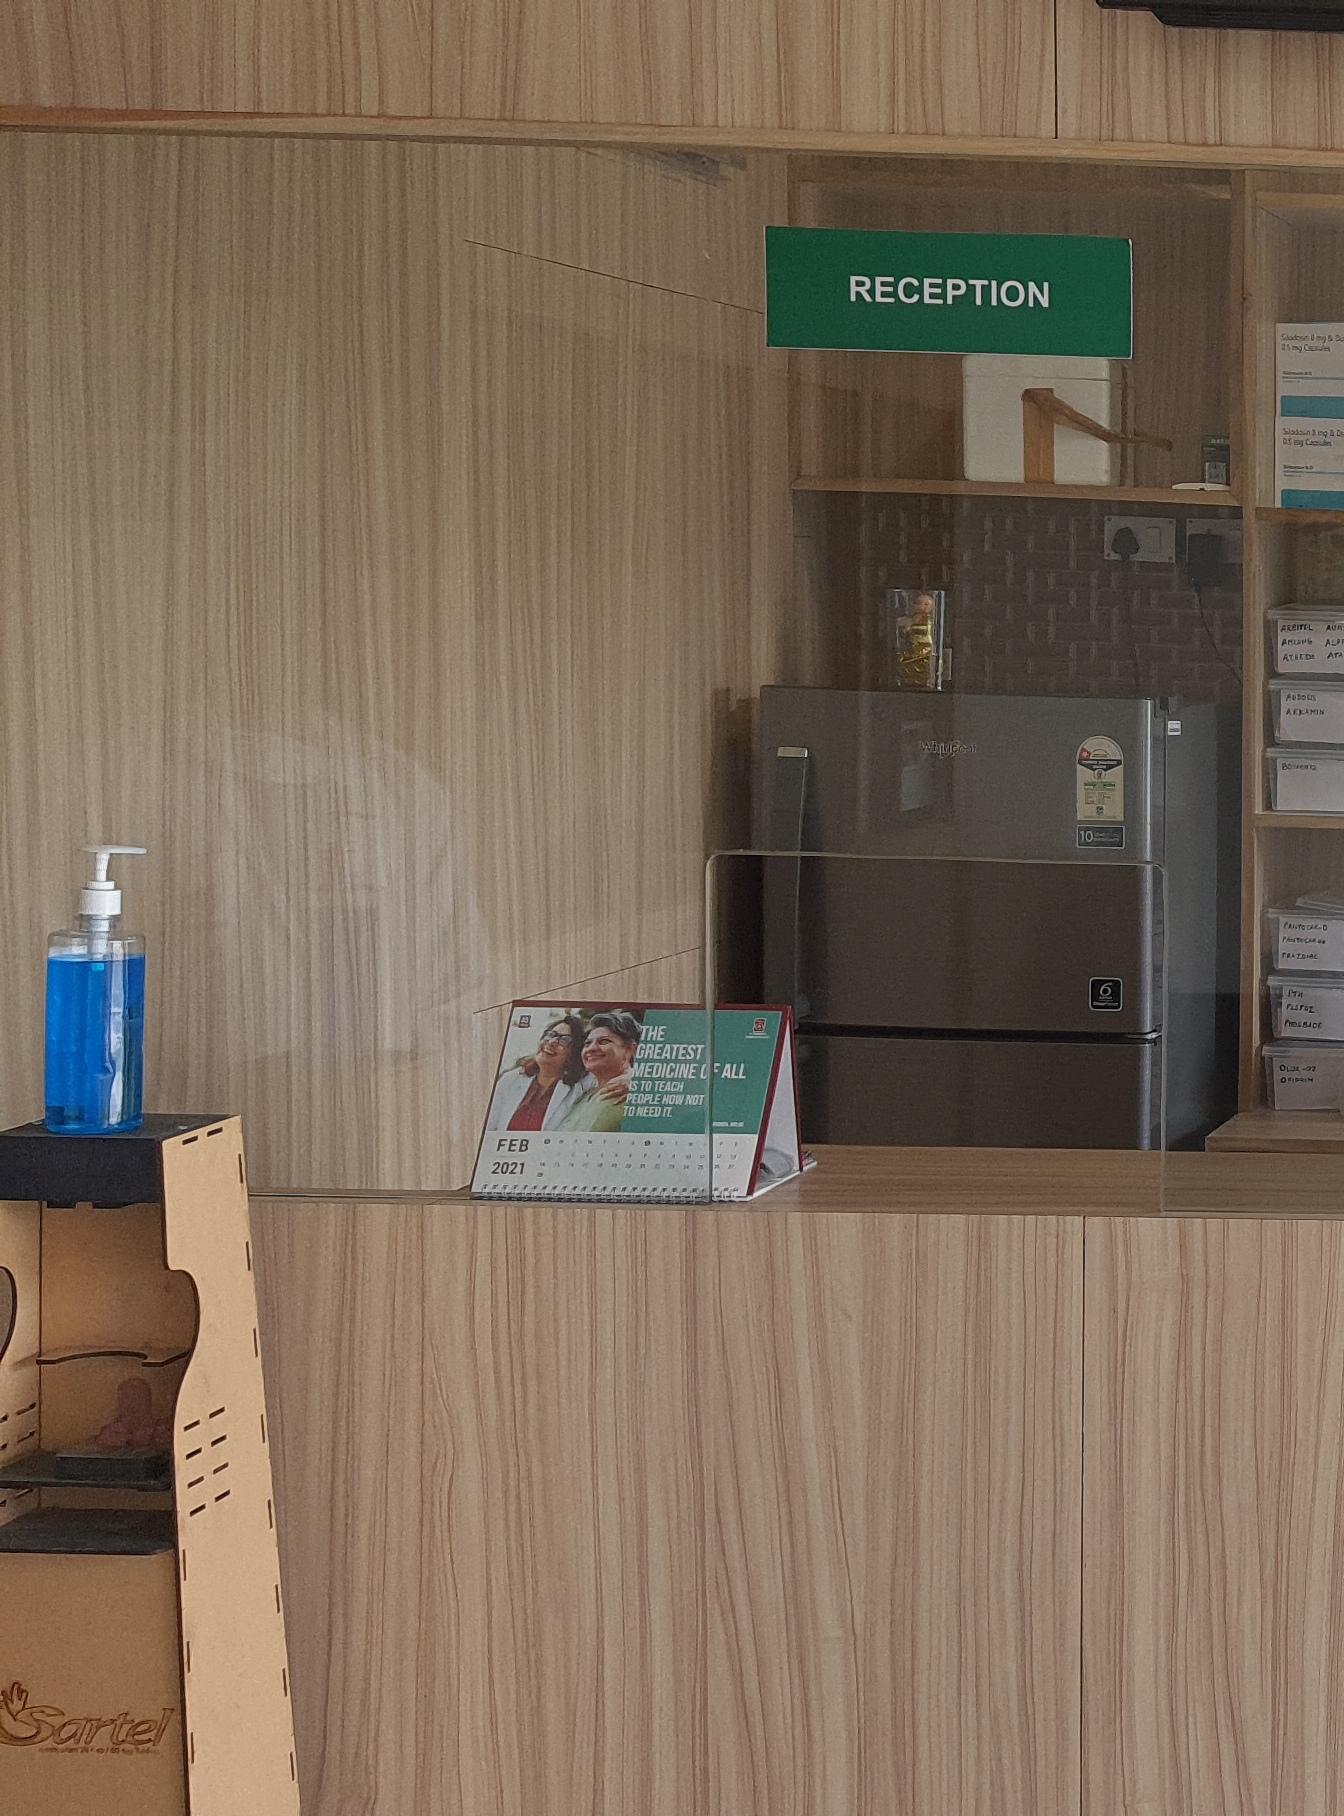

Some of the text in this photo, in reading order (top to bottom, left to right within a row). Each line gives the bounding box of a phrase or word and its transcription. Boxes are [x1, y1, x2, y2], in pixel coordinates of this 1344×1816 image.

[848, 274, 1051, 310] RECEPTION
[1079, 830, 1093, 843] 10
[640, 1025, 667, 1041] THE
[635, 1043, 705, 1061] GREATEST
[631, 1062, 699, 1080] MEDICINE
[721, 1063, 747, 1080] ALL
[640, 1081, 652, 1092] TO
[654, 1081, 685, 1092] TEACH
[626, 1094, 661, 1105] PEOPLE
[684, 1095, 705, 1106] NOT
[623, 1106, 635, 1118] TO
[636, 1106, 661, 1118] NEED
[496, 1138, 530, 1153] FEB
[491, 1161, 526, 1176] 2021
